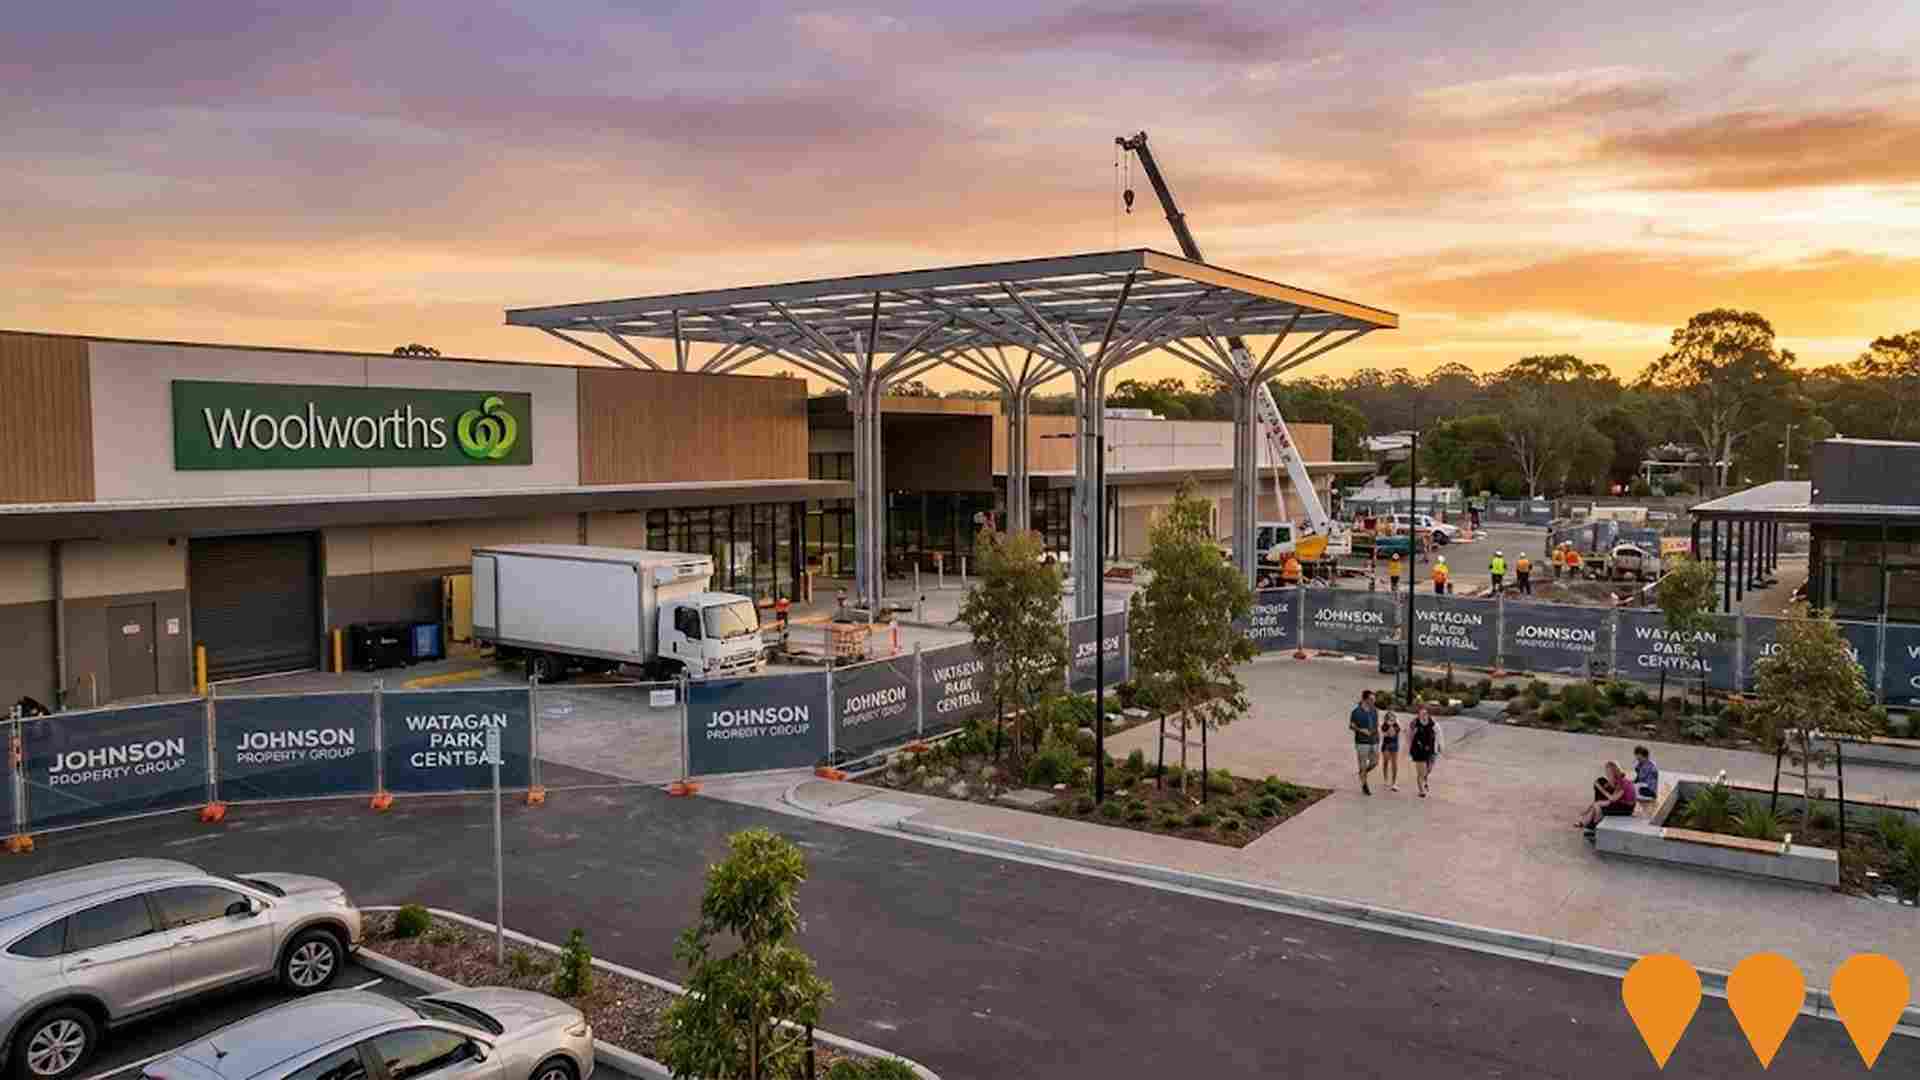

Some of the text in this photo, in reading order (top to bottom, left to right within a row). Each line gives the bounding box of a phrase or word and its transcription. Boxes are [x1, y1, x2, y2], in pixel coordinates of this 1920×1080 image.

[203, 402, 448, 450] Woolworths
[1314, 608, 1384, 624] JOHNSON
[1516, 625, 1597, 641] JOHNSON
[842, 686, 907, 714] JOHNSON
[405, 713, 507, 731] WATAGAN
[707, 705, 809, 727] JOHNSON
[237, 727, 355, 750] JOHNSON
[430, 731, 485, 748] PARK
[48, 737, 186, 773] JOHNSON
[237, 746, 356, 763] PROPERTY GROUP
[48, 757, 186, 786] PROPERTY GROUP
